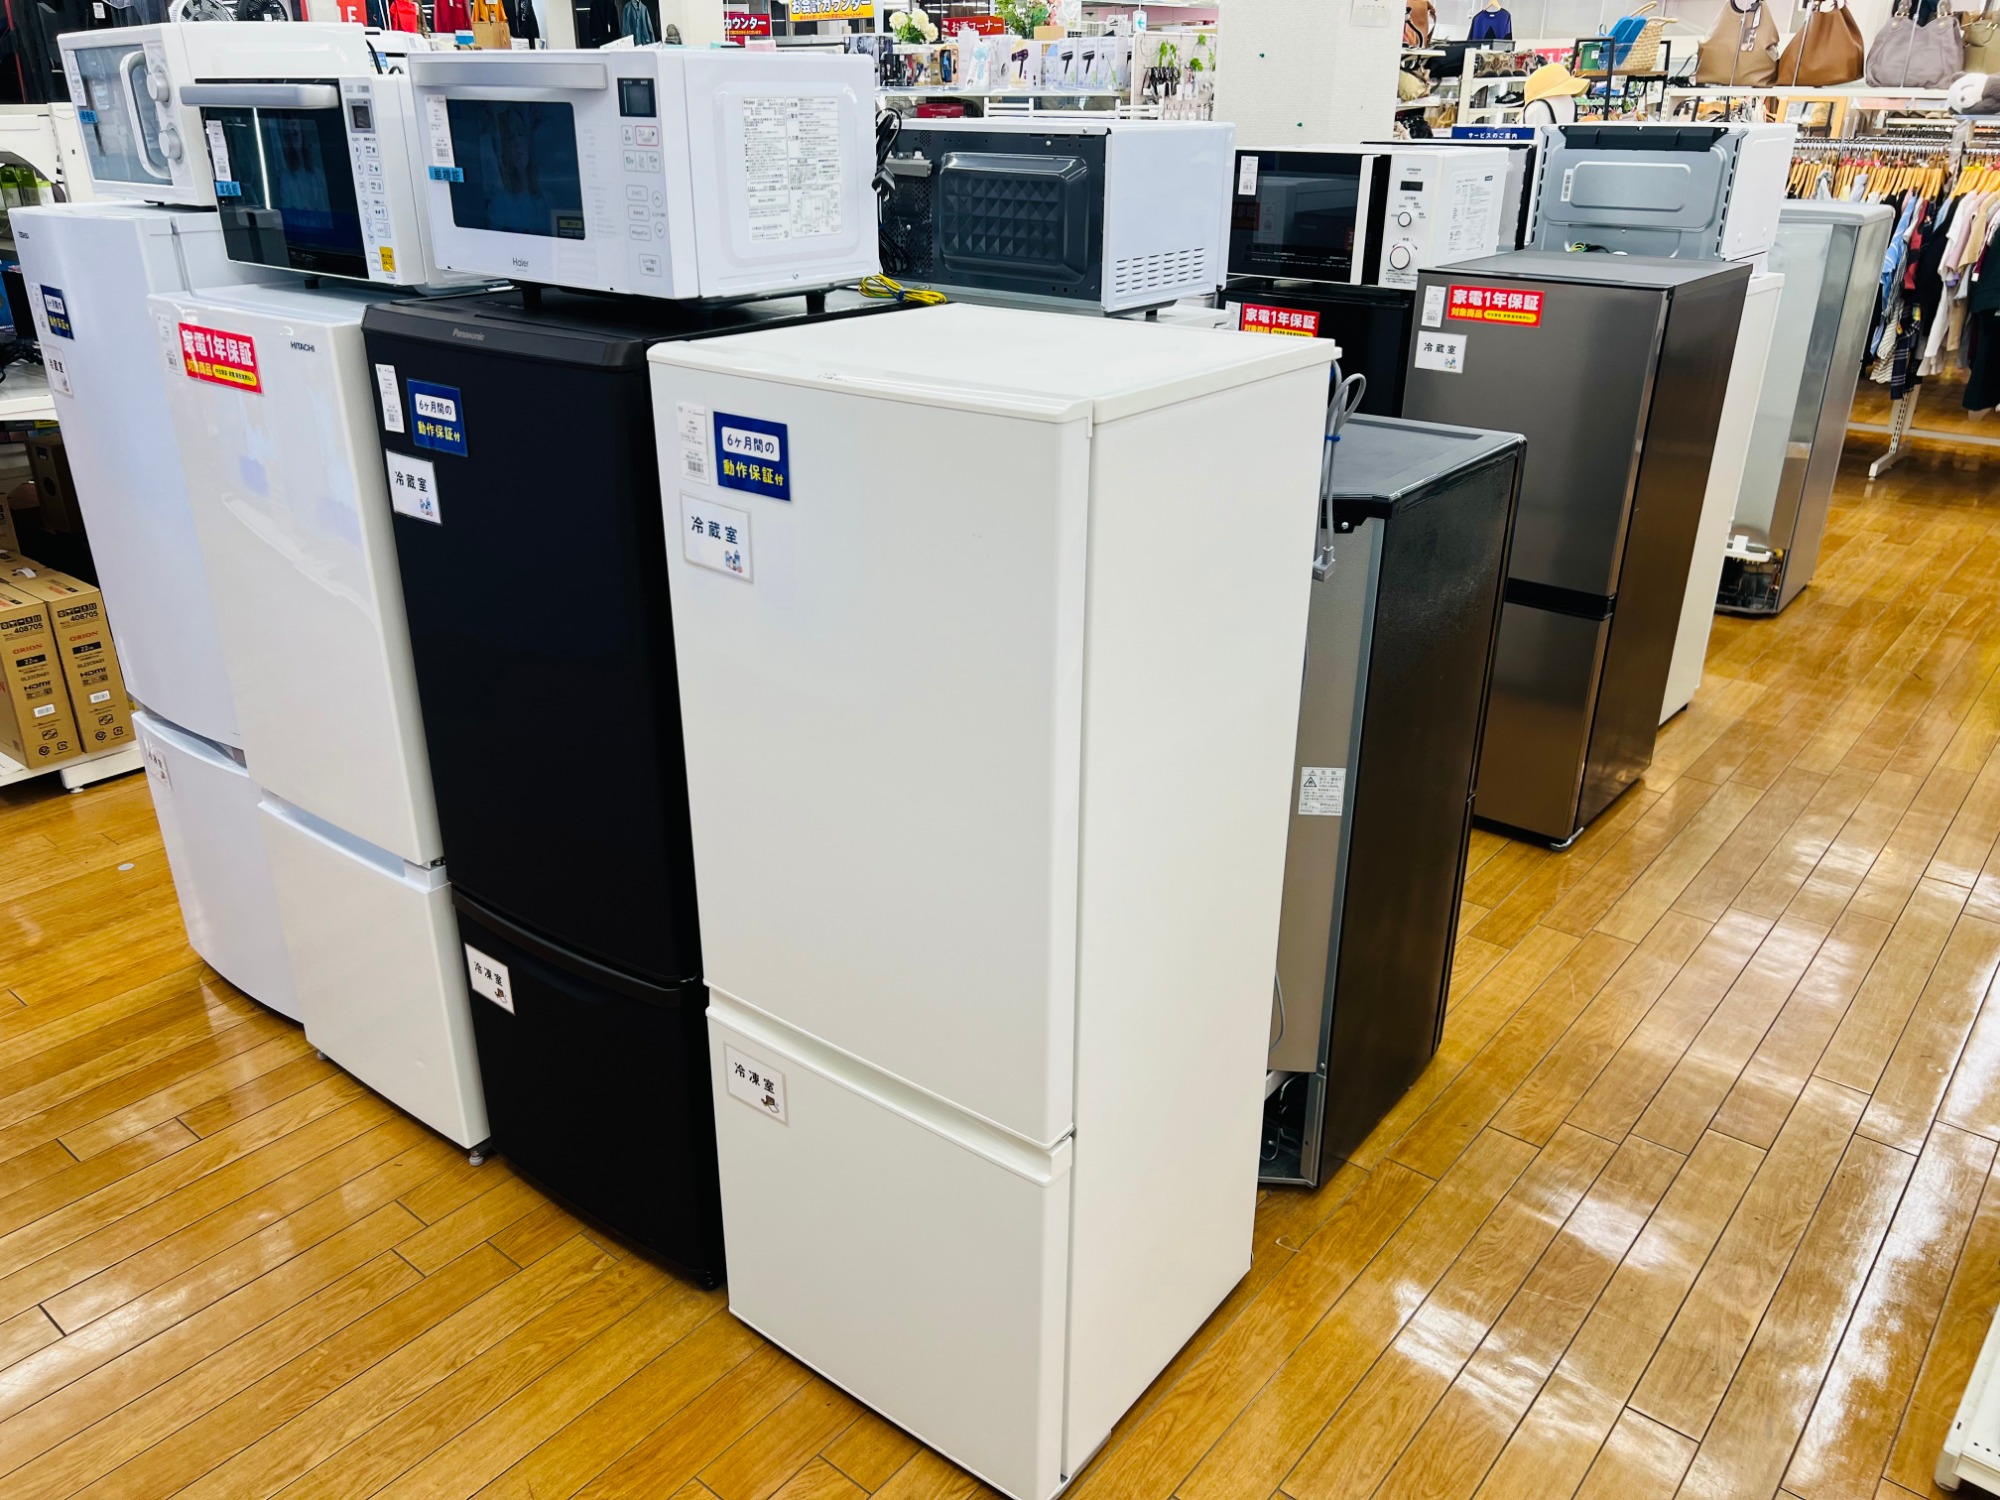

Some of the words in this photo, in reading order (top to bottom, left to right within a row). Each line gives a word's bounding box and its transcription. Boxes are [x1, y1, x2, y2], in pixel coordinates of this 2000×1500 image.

[1468, 132, 1518, 140] サービスのご案内
[512, 257, 530, 268] Haier
[1452, 289, 1539, 311] 家電1年保証
[1245, 307, 1316, 330] 家電1年保証
[1451, 307, 1483, 319] 対象商品
[452, 328, 485, 341] Panasonic
[182, 329, 255, 367] 家電1年保証
[290, 341, 315, 353] HITACHI
[1423, 342, 1456, 354] 冷蔵室
[418, 398, 453, 416] 6ヶ月間の
[417, 420, 461, 443] 動作保証付
[726, 433, 775, 454] 6ヶ月間の
[722, 459, 785, 486] 動作保証付
[394, 470, 428, 493] 冷蔵室
[691, 516, 738, 545] 冷蔵室
[70, 610, 99, 622] 408705
[13, 623, 44, 634] 408705
[69, 630, 98, 642] ORION
[12, 643, 43, 655] ORION
[79, 666, 107, 678] HDMI
[23, 679, 51, 691] HDMI
[734, 1061, 775, 1095] 冷凍室
